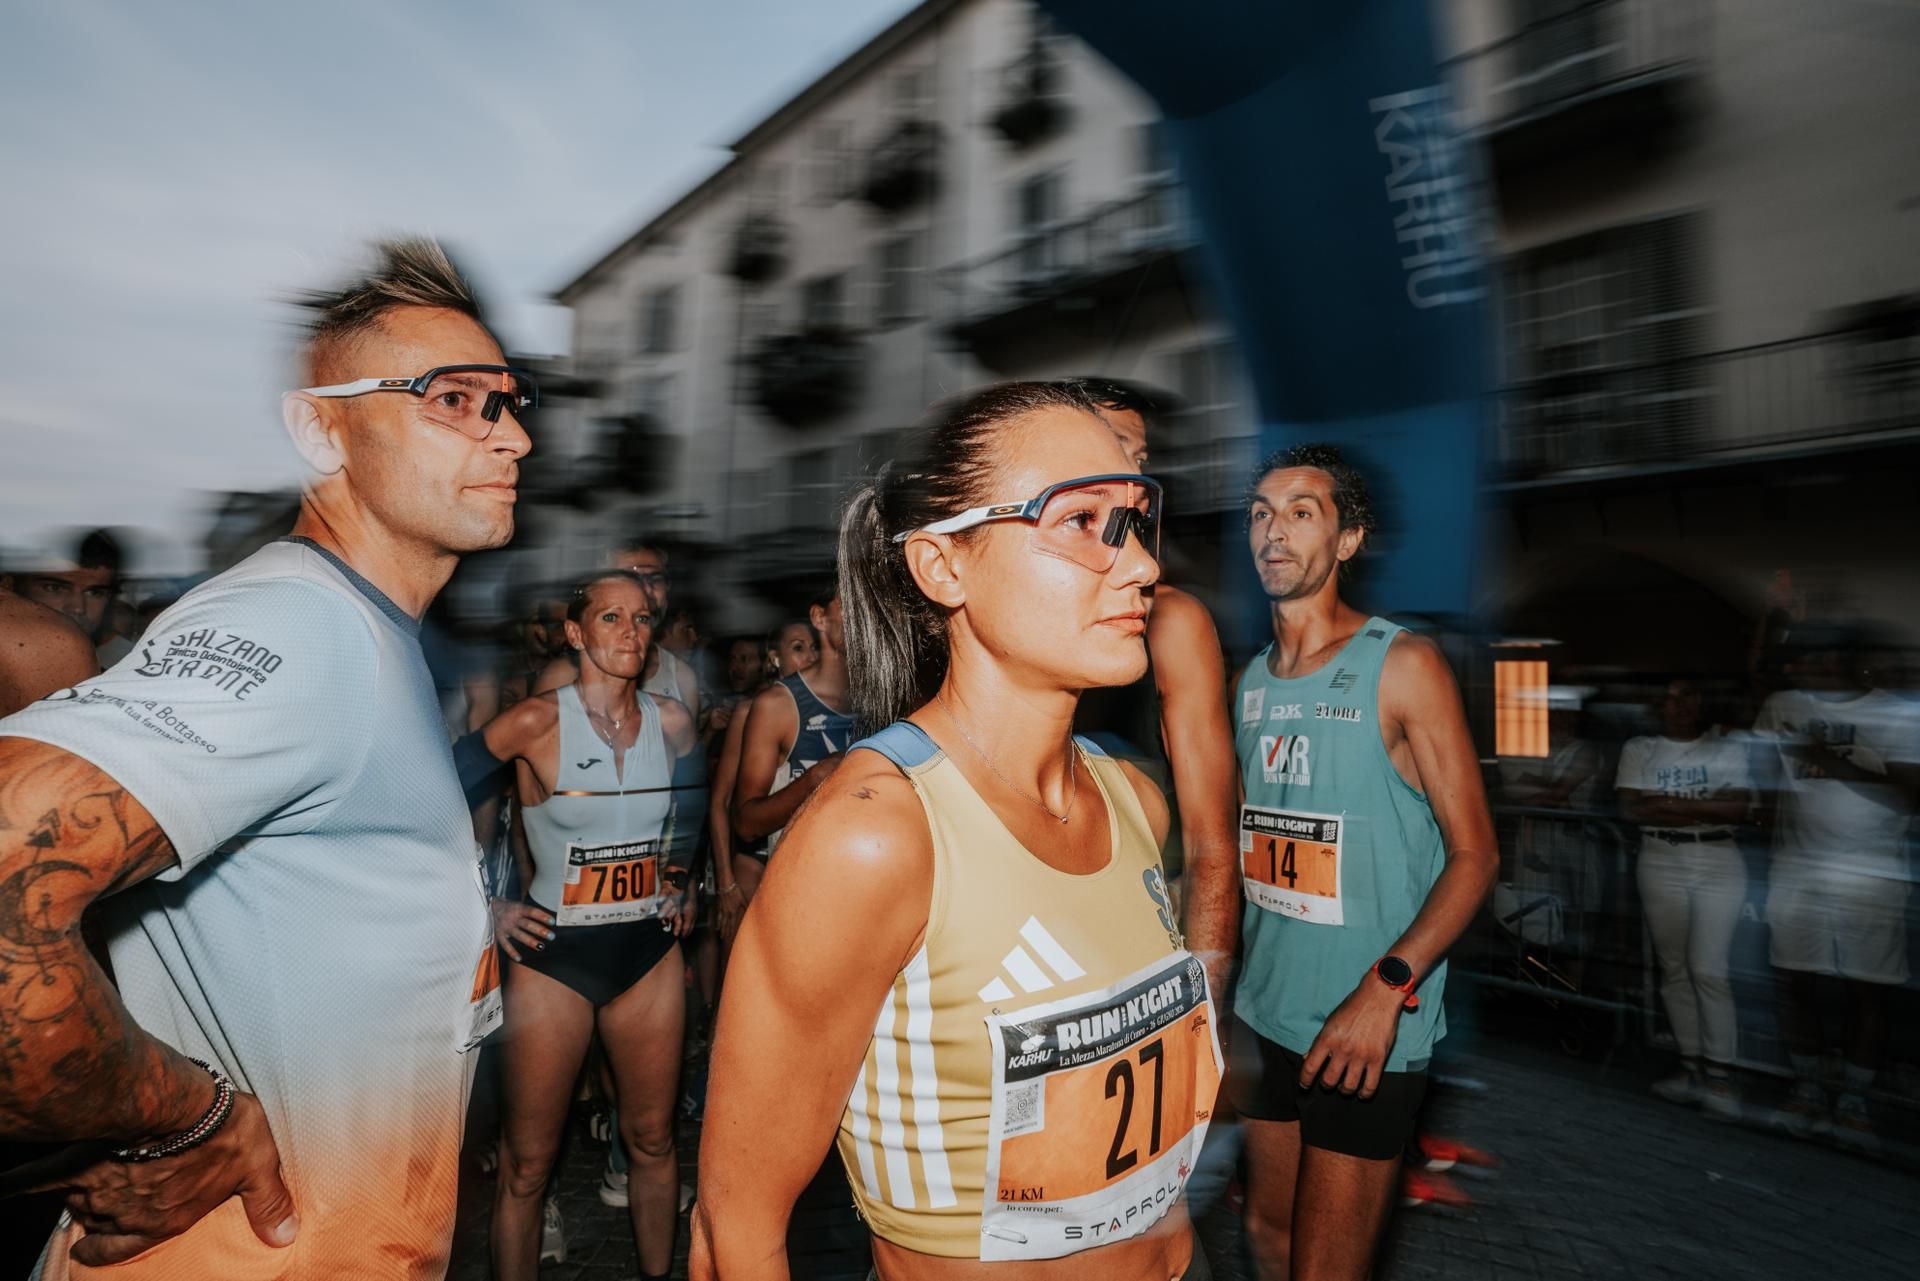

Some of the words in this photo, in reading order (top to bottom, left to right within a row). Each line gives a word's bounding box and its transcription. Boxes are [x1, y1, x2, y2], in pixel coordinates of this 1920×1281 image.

[1368, 84, 1484, 309] KARHU
[199, 650, 267, 684] Odontoiatrica
[156, 706, 218, 753] Bottasso
[1254, 814, 1274, 828] RUN
[585, 848, 612, 861] RUN
[1268, 839, 1298, 888] 14
[591, 862, 644, 902] 760
[1056, 1007, 1121, 1052] RUN
[1008, 1048, 1053, 1069] KARHU
[1060, 1054, 1070, 1067] La
[1071, 1048, 1095, 1065] Mezza
[1096, 1038, 1124, 1056] Maratona
[1105, 1038, 1164, 1180] 27
[1001, 1189, 1015, 1200] 21
[1021, 1186, 1043, 1200] KM
[1065, 1180, 1177, 1241] STAPROL
